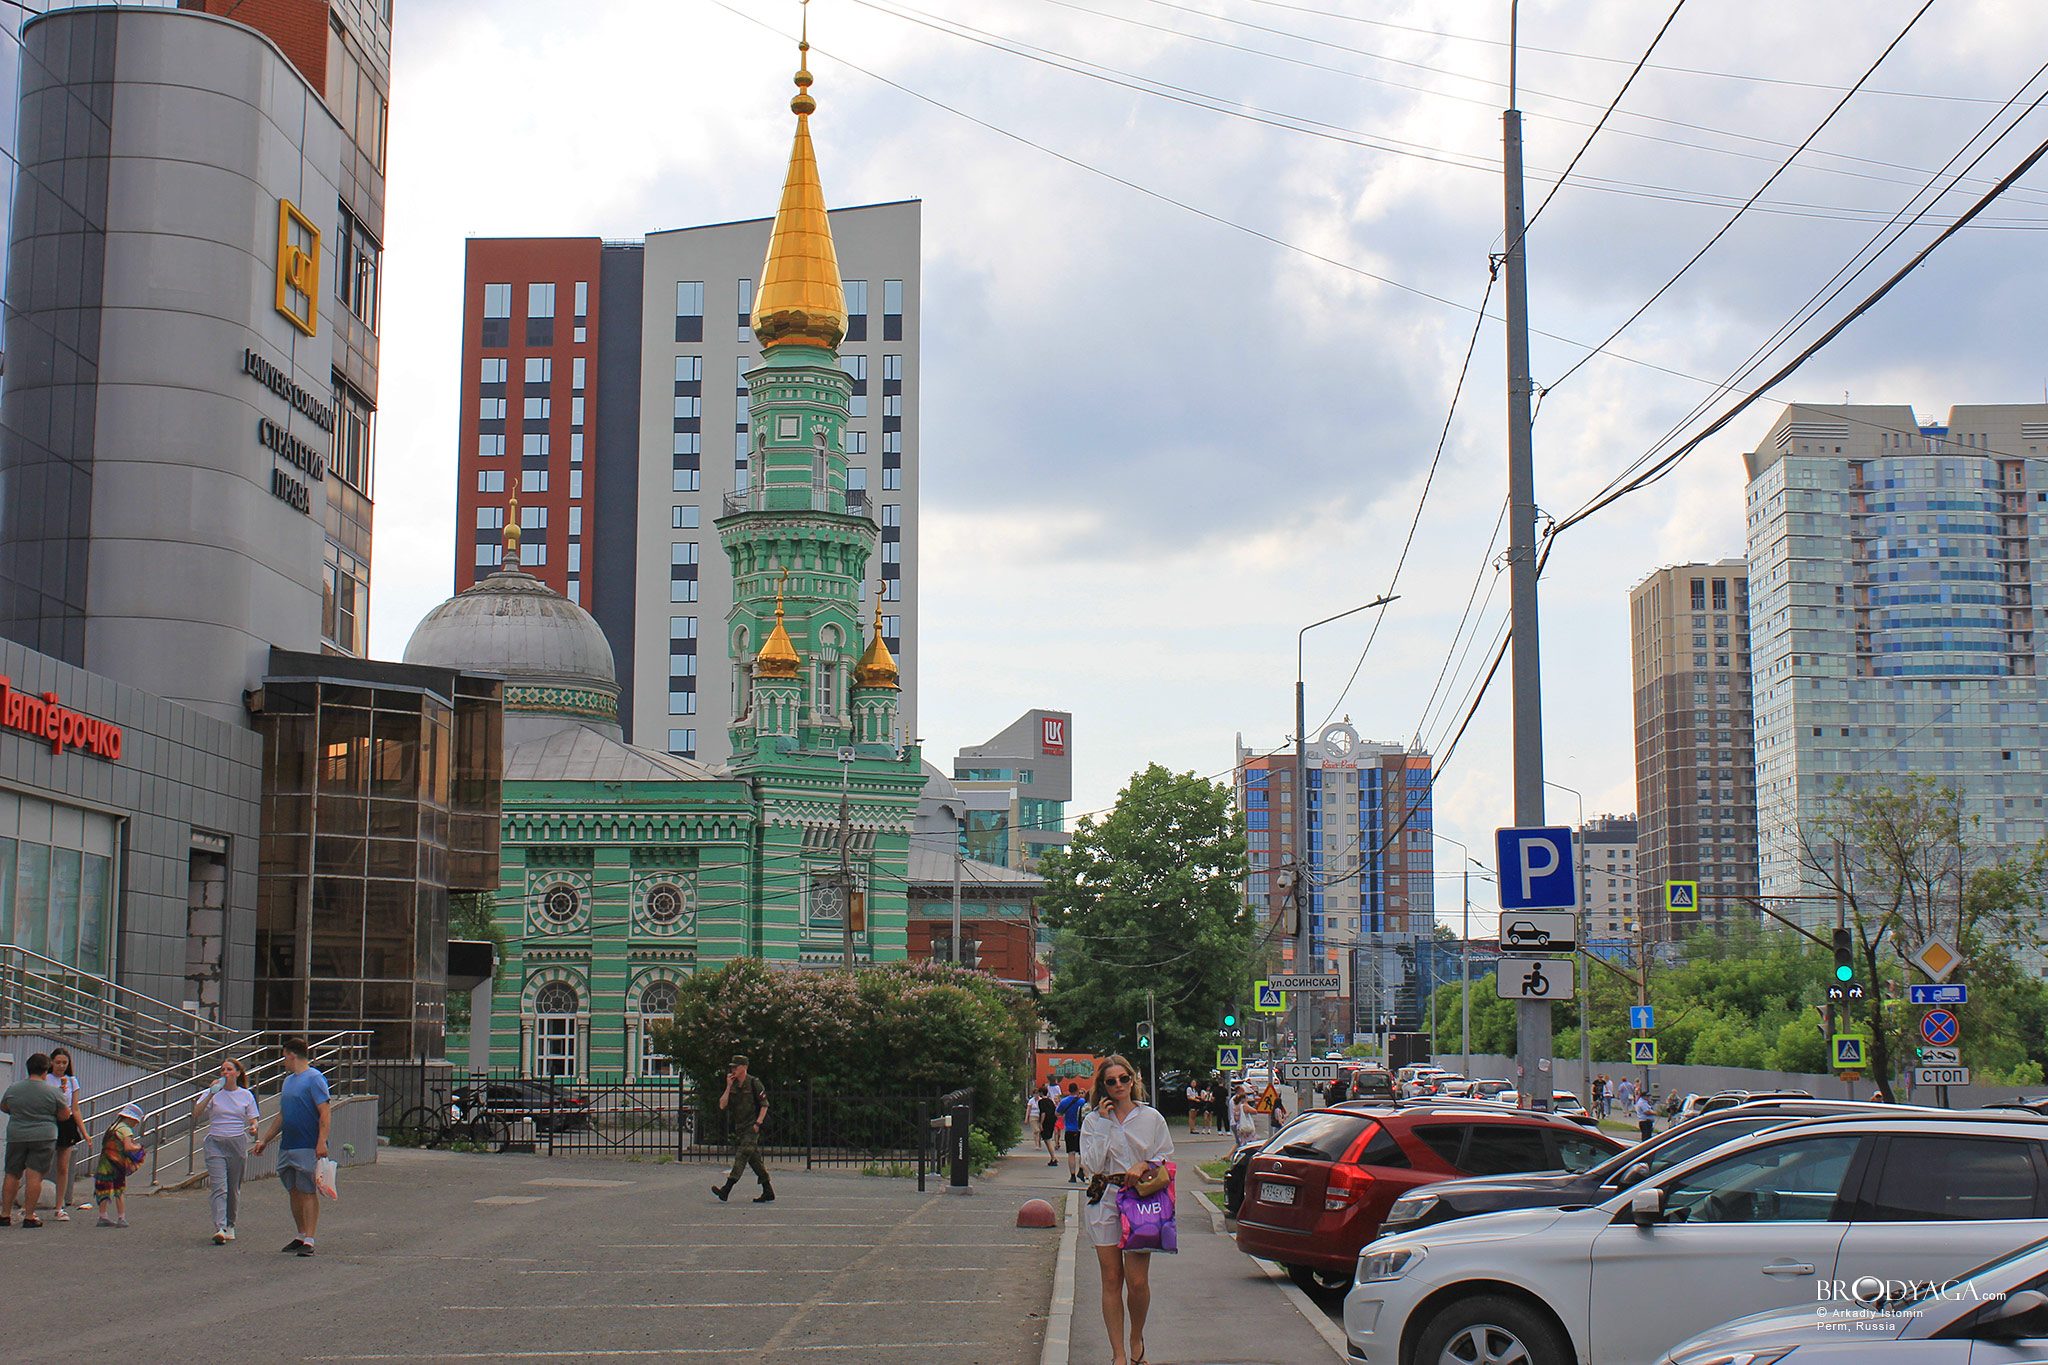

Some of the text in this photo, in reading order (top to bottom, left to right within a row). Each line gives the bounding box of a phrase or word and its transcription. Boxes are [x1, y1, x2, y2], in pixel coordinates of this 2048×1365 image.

[244, 347, 337, 435] LAWYERS COMPANY
[260, 417, 325, 483] СТРАТЕГИЯ
[273, 467, 311, 515] ПРАВА
[1340, 759, 1358, 769] Park
[1519, 837, 1560, 899] P
[1270, 977, 1338, 989] ул.ОСИНСКАЯ
[1291, 1065, 1332, 1078] СТОП
[1922, 1069, 1964, 1083] СТОП
[1136, 1202, 1162, 1215] WB
